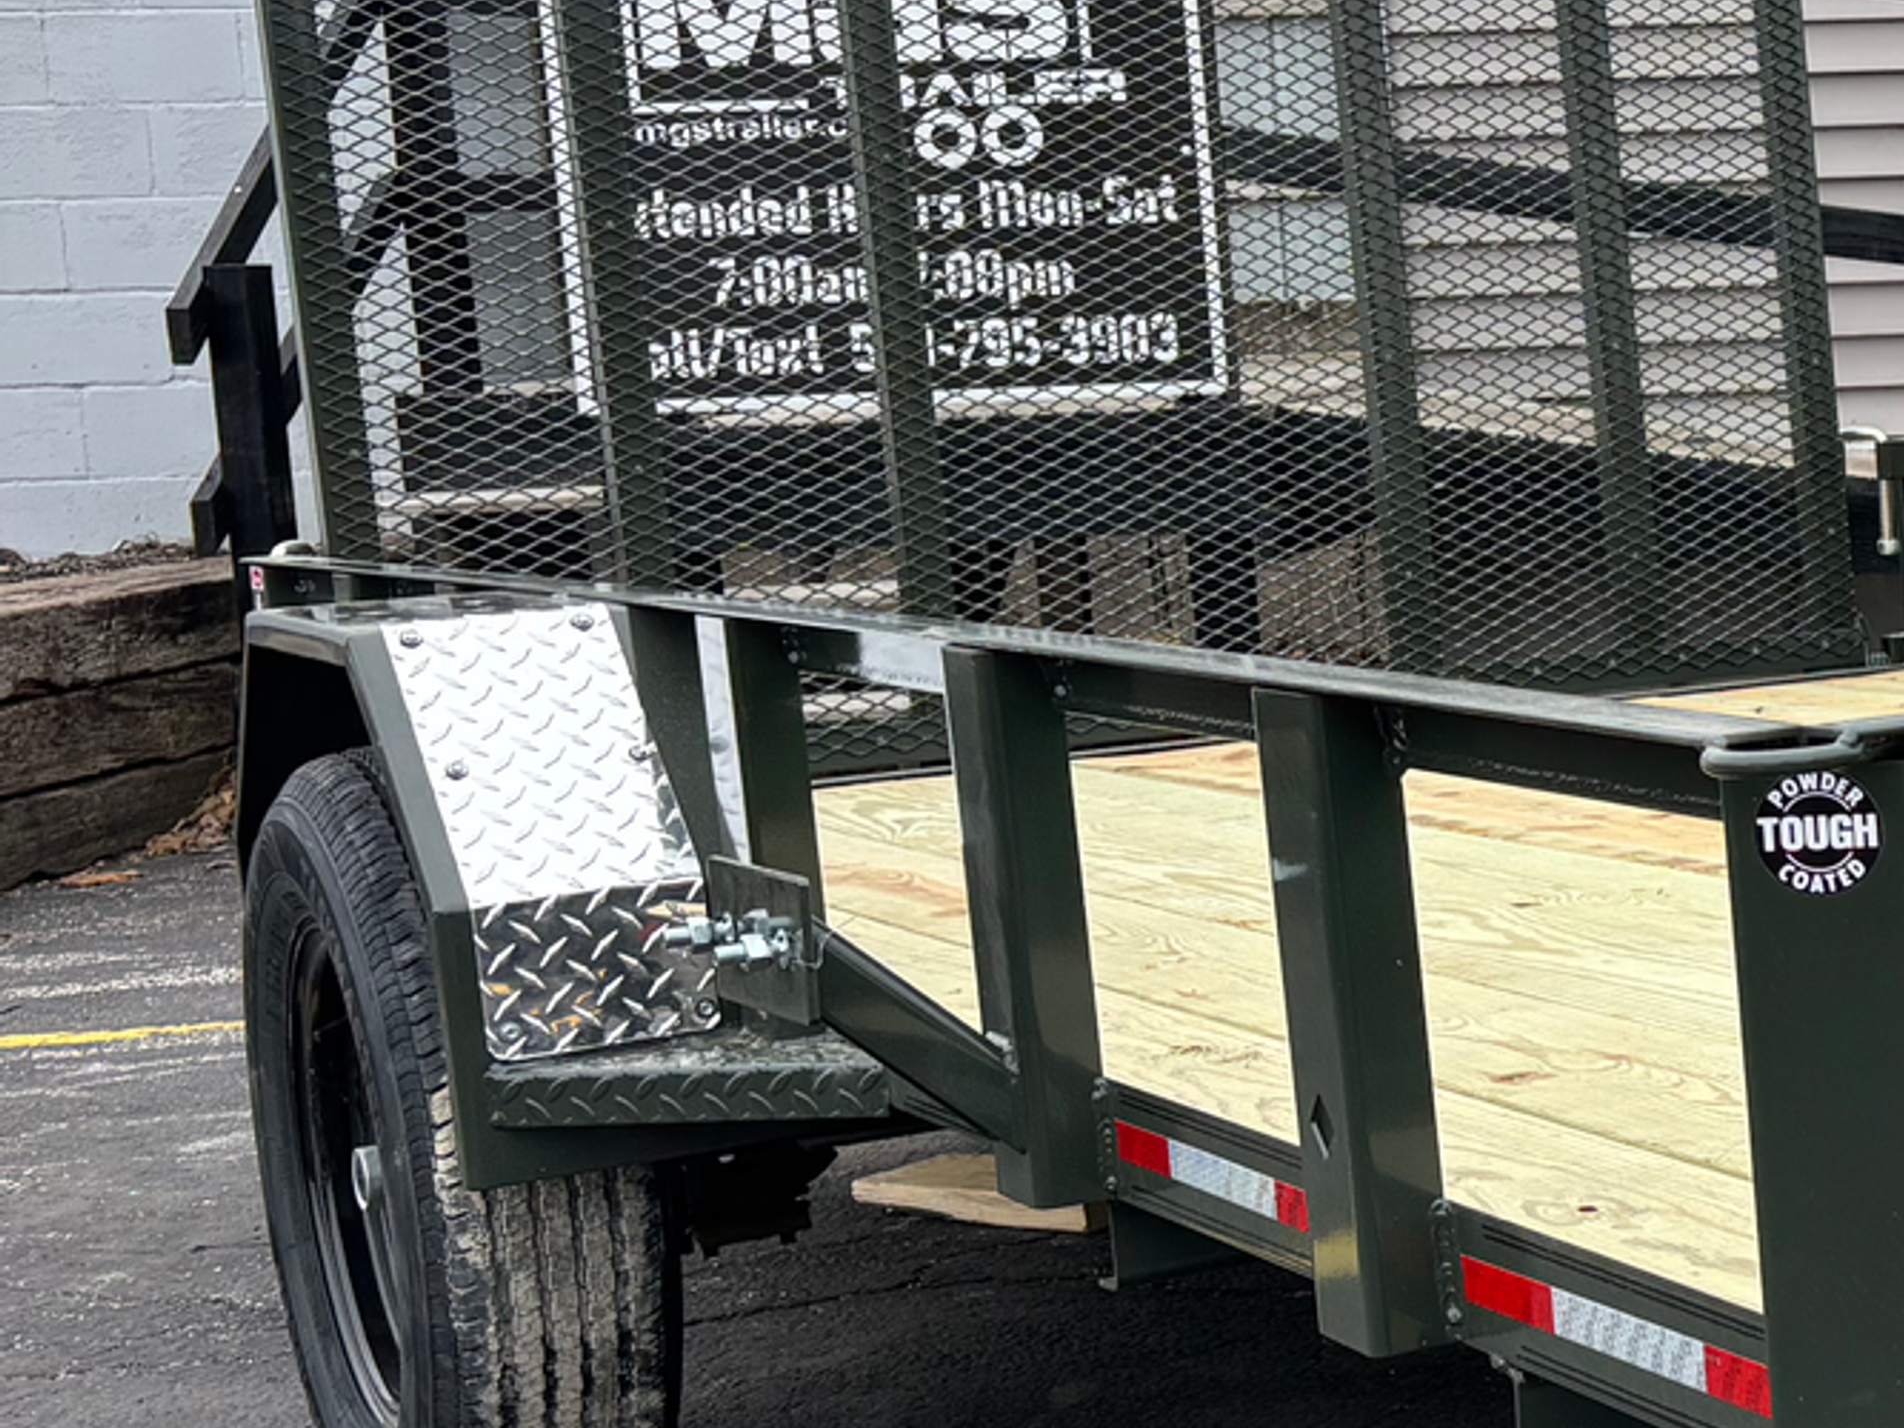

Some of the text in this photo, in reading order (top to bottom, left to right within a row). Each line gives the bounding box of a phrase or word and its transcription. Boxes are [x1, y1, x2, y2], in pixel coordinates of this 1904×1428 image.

[634, 115, 848, 148] mgstrailer.c
[634, 172, 1181, 240] tended Hrs Mon-Sat
[647, 324, 825, 383] all/Text
[1767, 772, 1864, 809] POWDER
[1755, 813, 1879, 853] TOUGH
[1778, 858, 1867, 894] COATED
